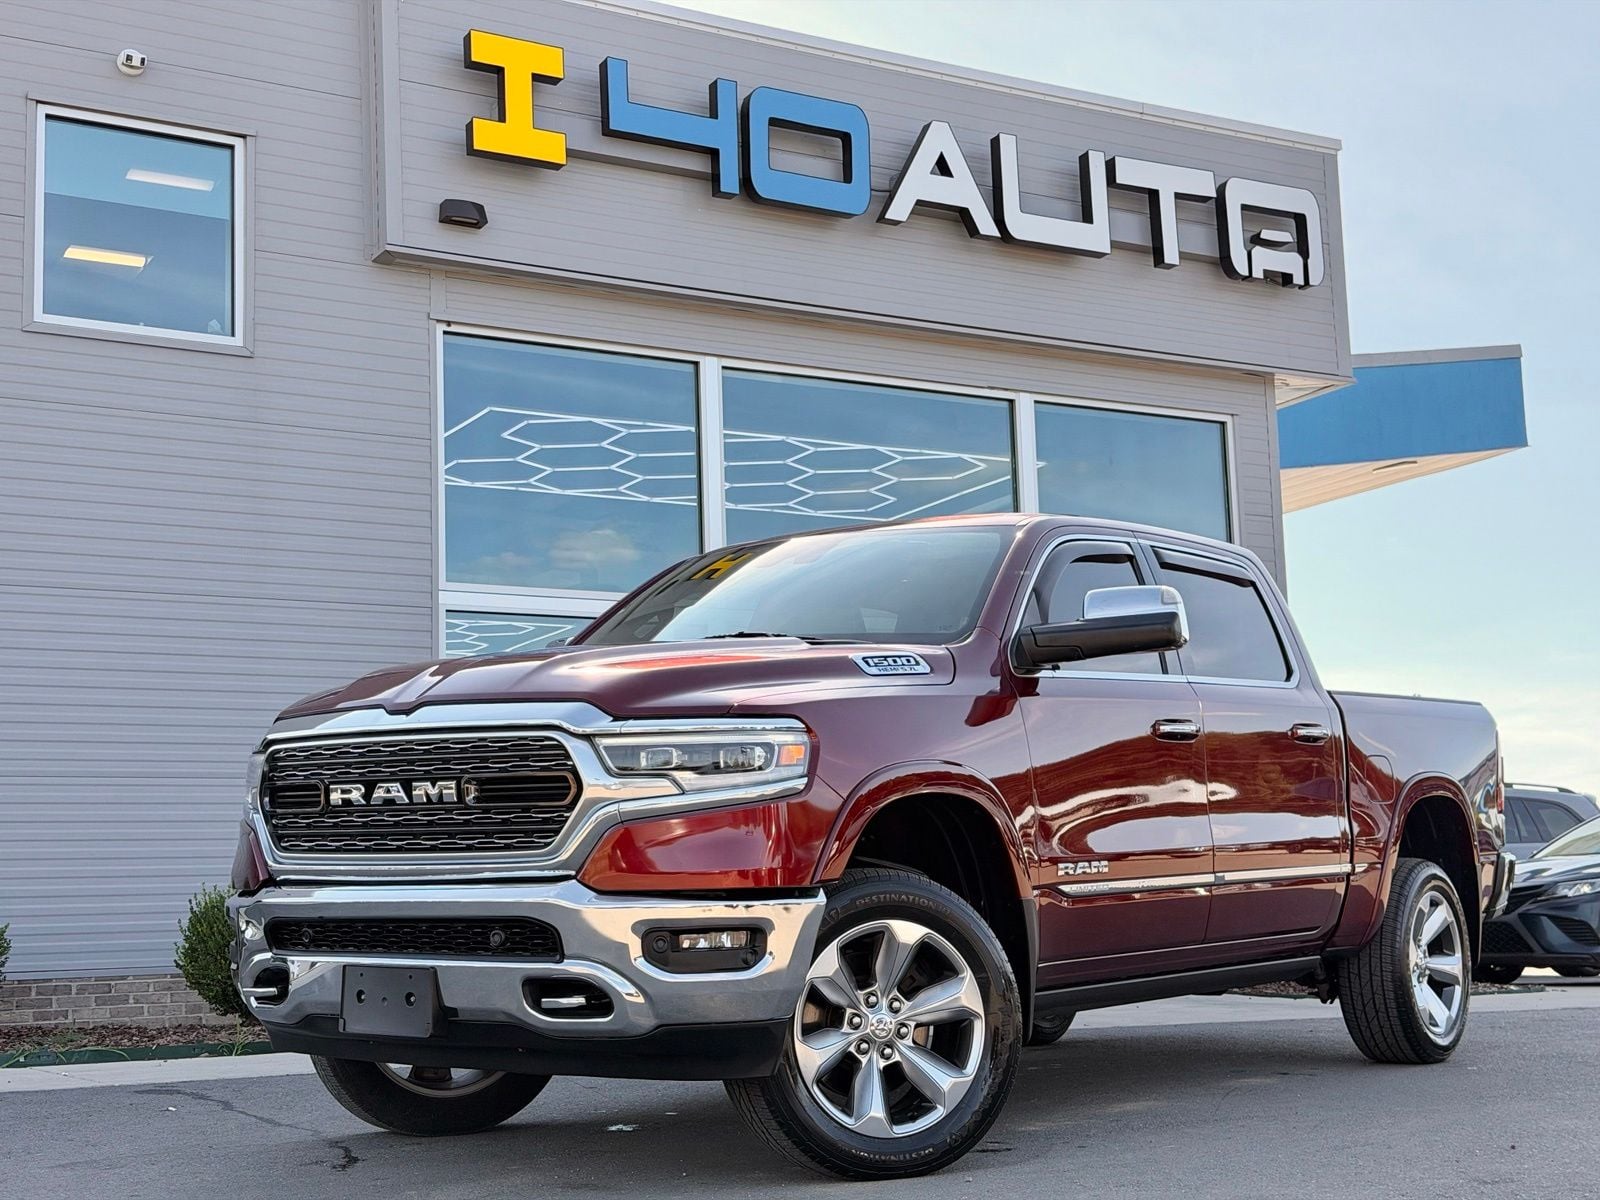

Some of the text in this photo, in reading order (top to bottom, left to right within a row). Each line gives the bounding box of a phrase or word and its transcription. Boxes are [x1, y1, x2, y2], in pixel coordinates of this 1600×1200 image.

[878, 119, 1325, 289] AUTO
[863, 656, 916, 667] 1500
[328, 779, 458, 806] RAM
[1057, 860, 1109, 877] RAM
